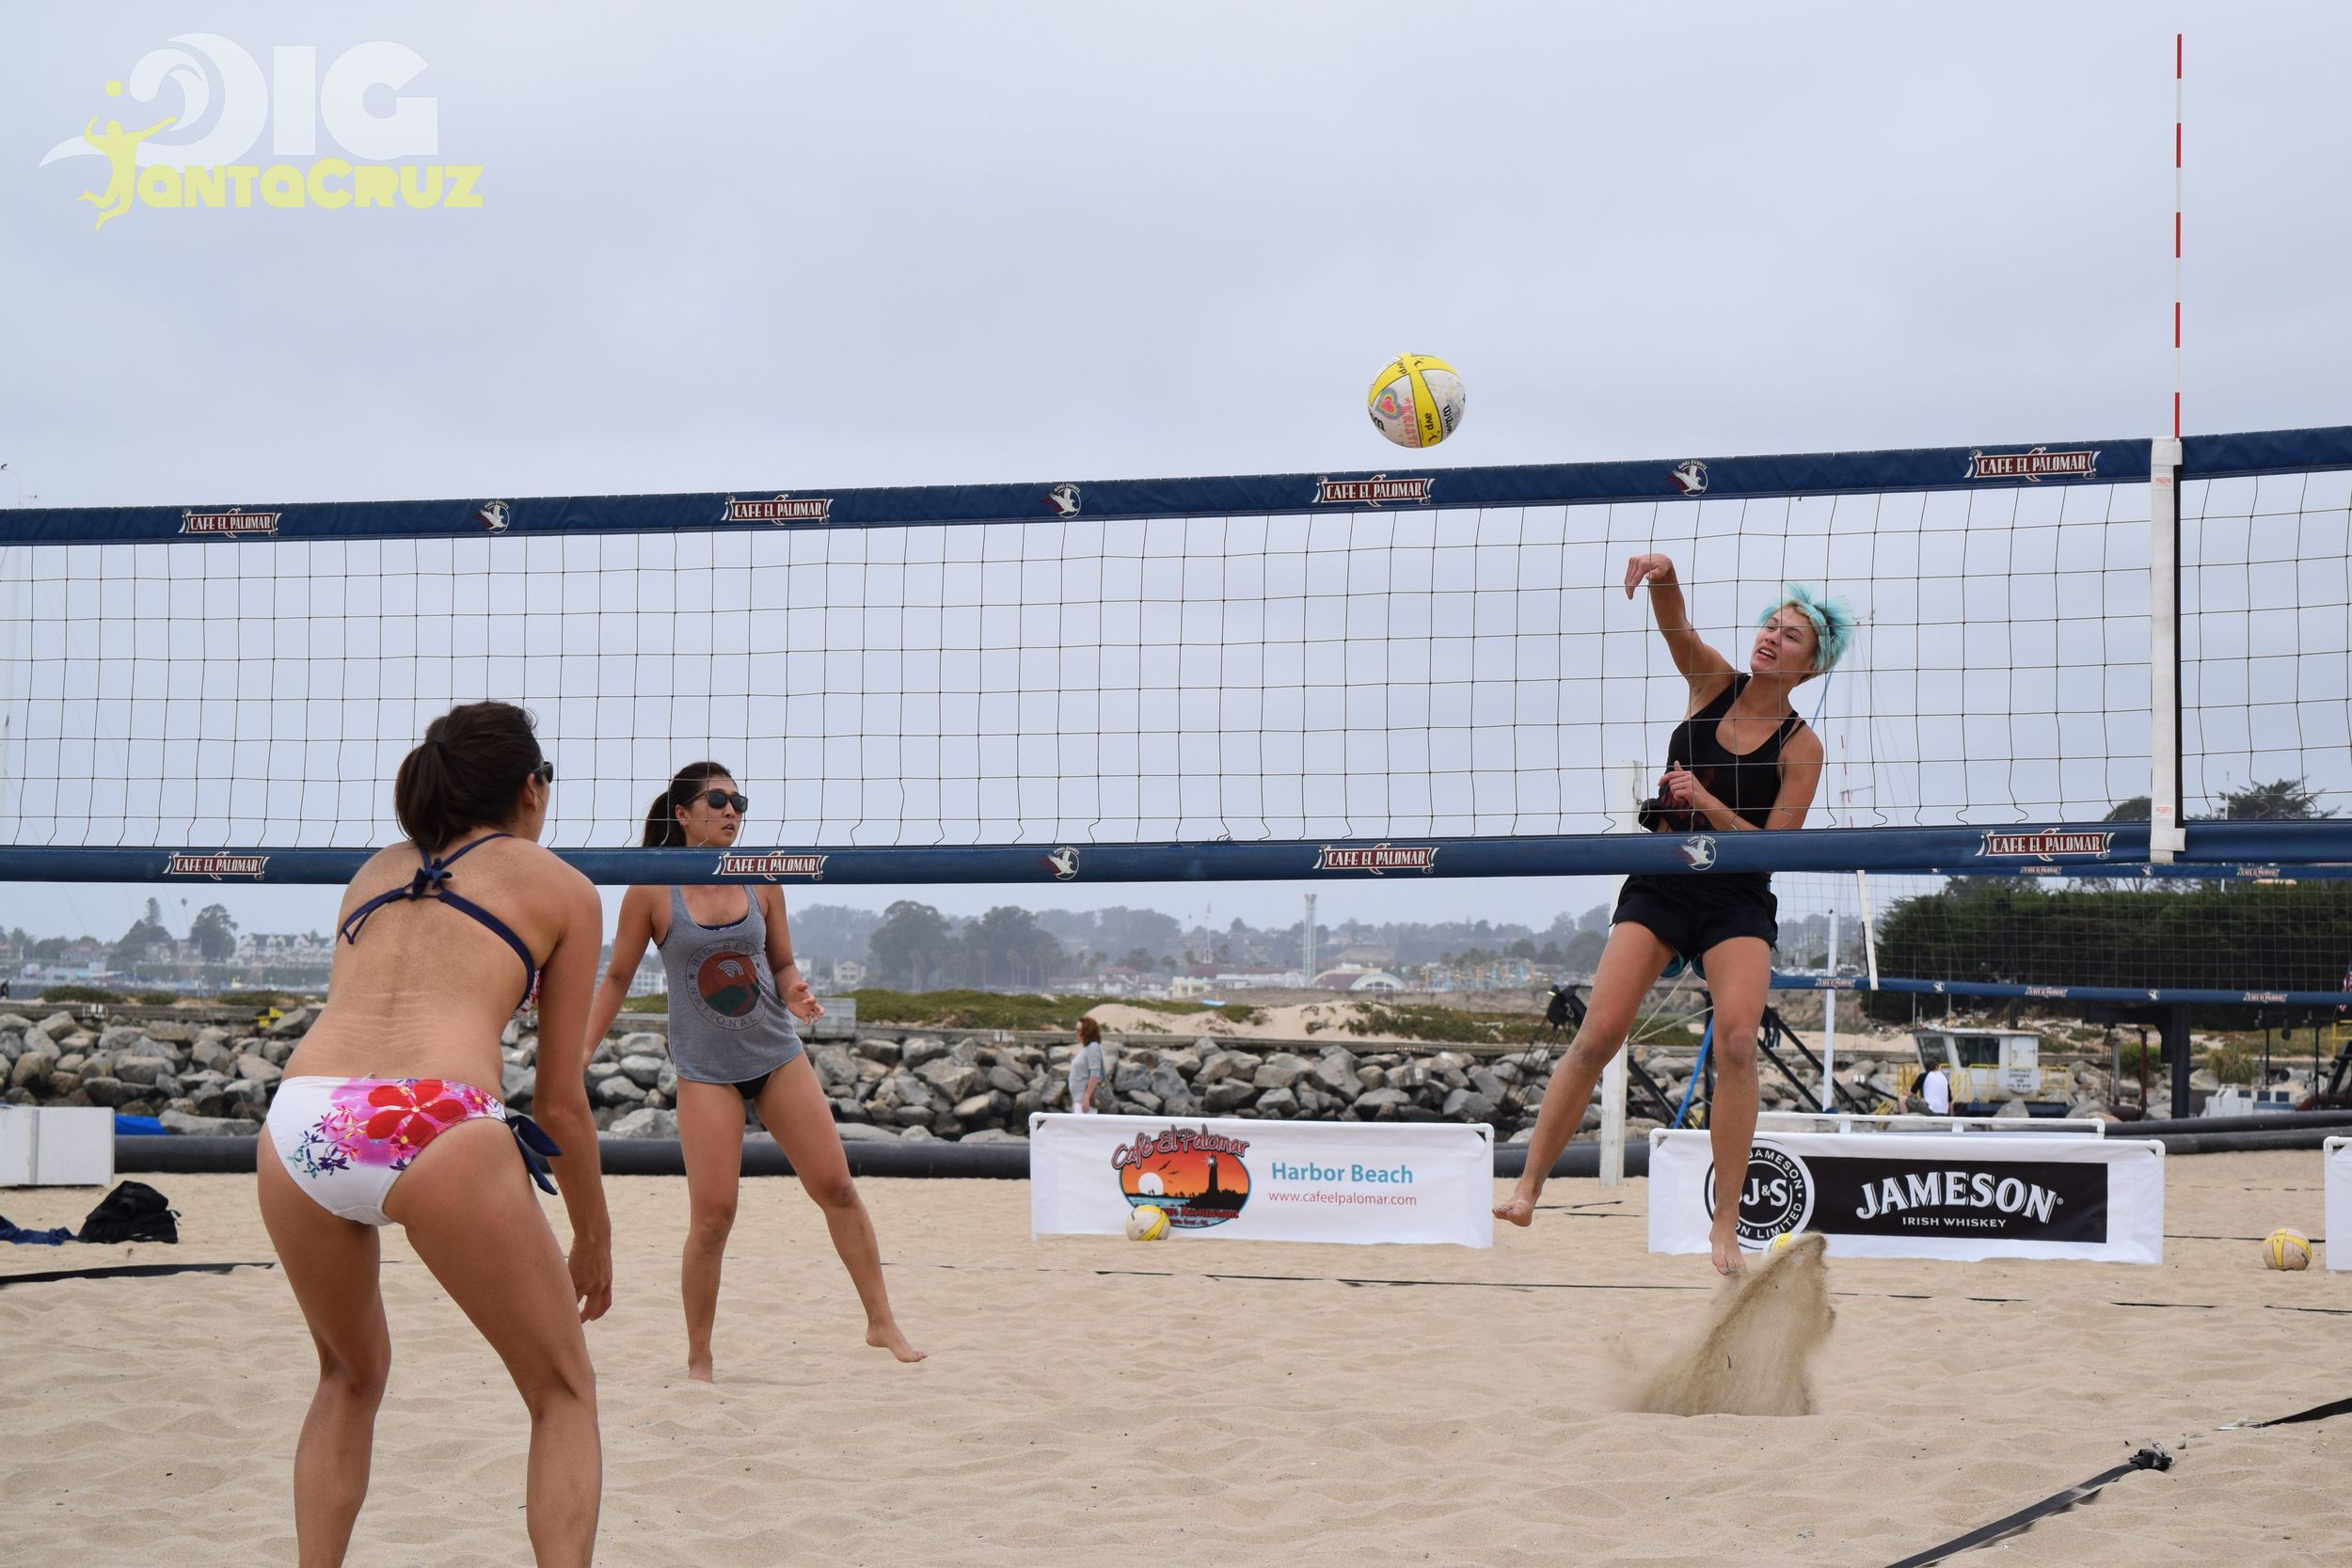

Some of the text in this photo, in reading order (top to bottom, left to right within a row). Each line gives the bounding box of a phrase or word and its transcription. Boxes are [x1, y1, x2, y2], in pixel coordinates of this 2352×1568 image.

[1424, 412, 1436, 431] avp
[1980, 455, 2086, 474] CAFE EL PALOMAR
[1327, 482, 1422, 499] CAFE EL PALOMAR
[734, 502, 822, 518] CAFE EL PALOMAR
[190, 515, 271, 531] CAFE EL PALOMAR
[1993, 836, 2100, 853] CAFE EL PALOMAR
[176, 858, 259, 872] CAFE EL PALOMAR
[727, 858, 816, 872] CAFE EL PALOMAR
[1328, 850, 1425, 865] CAFE EL PALOMAR
[691, 947, 713, 966] BIG
[691, 988, 757, 1028] NATIONAL
[1110, 1122, 1250, 1170] Café El Palomar
[1271, 1162, 1413, 1184] Harbor Beach
[1268, 1191, 1418, 1206] www.cafeelpalomar.com
[1855, 1171, 2058, 1224] JAMESON
[1756, 1202, 1803, 1239] LIMITED
[1902, 1216, 2007, 1227] IRISH WHISKEY
